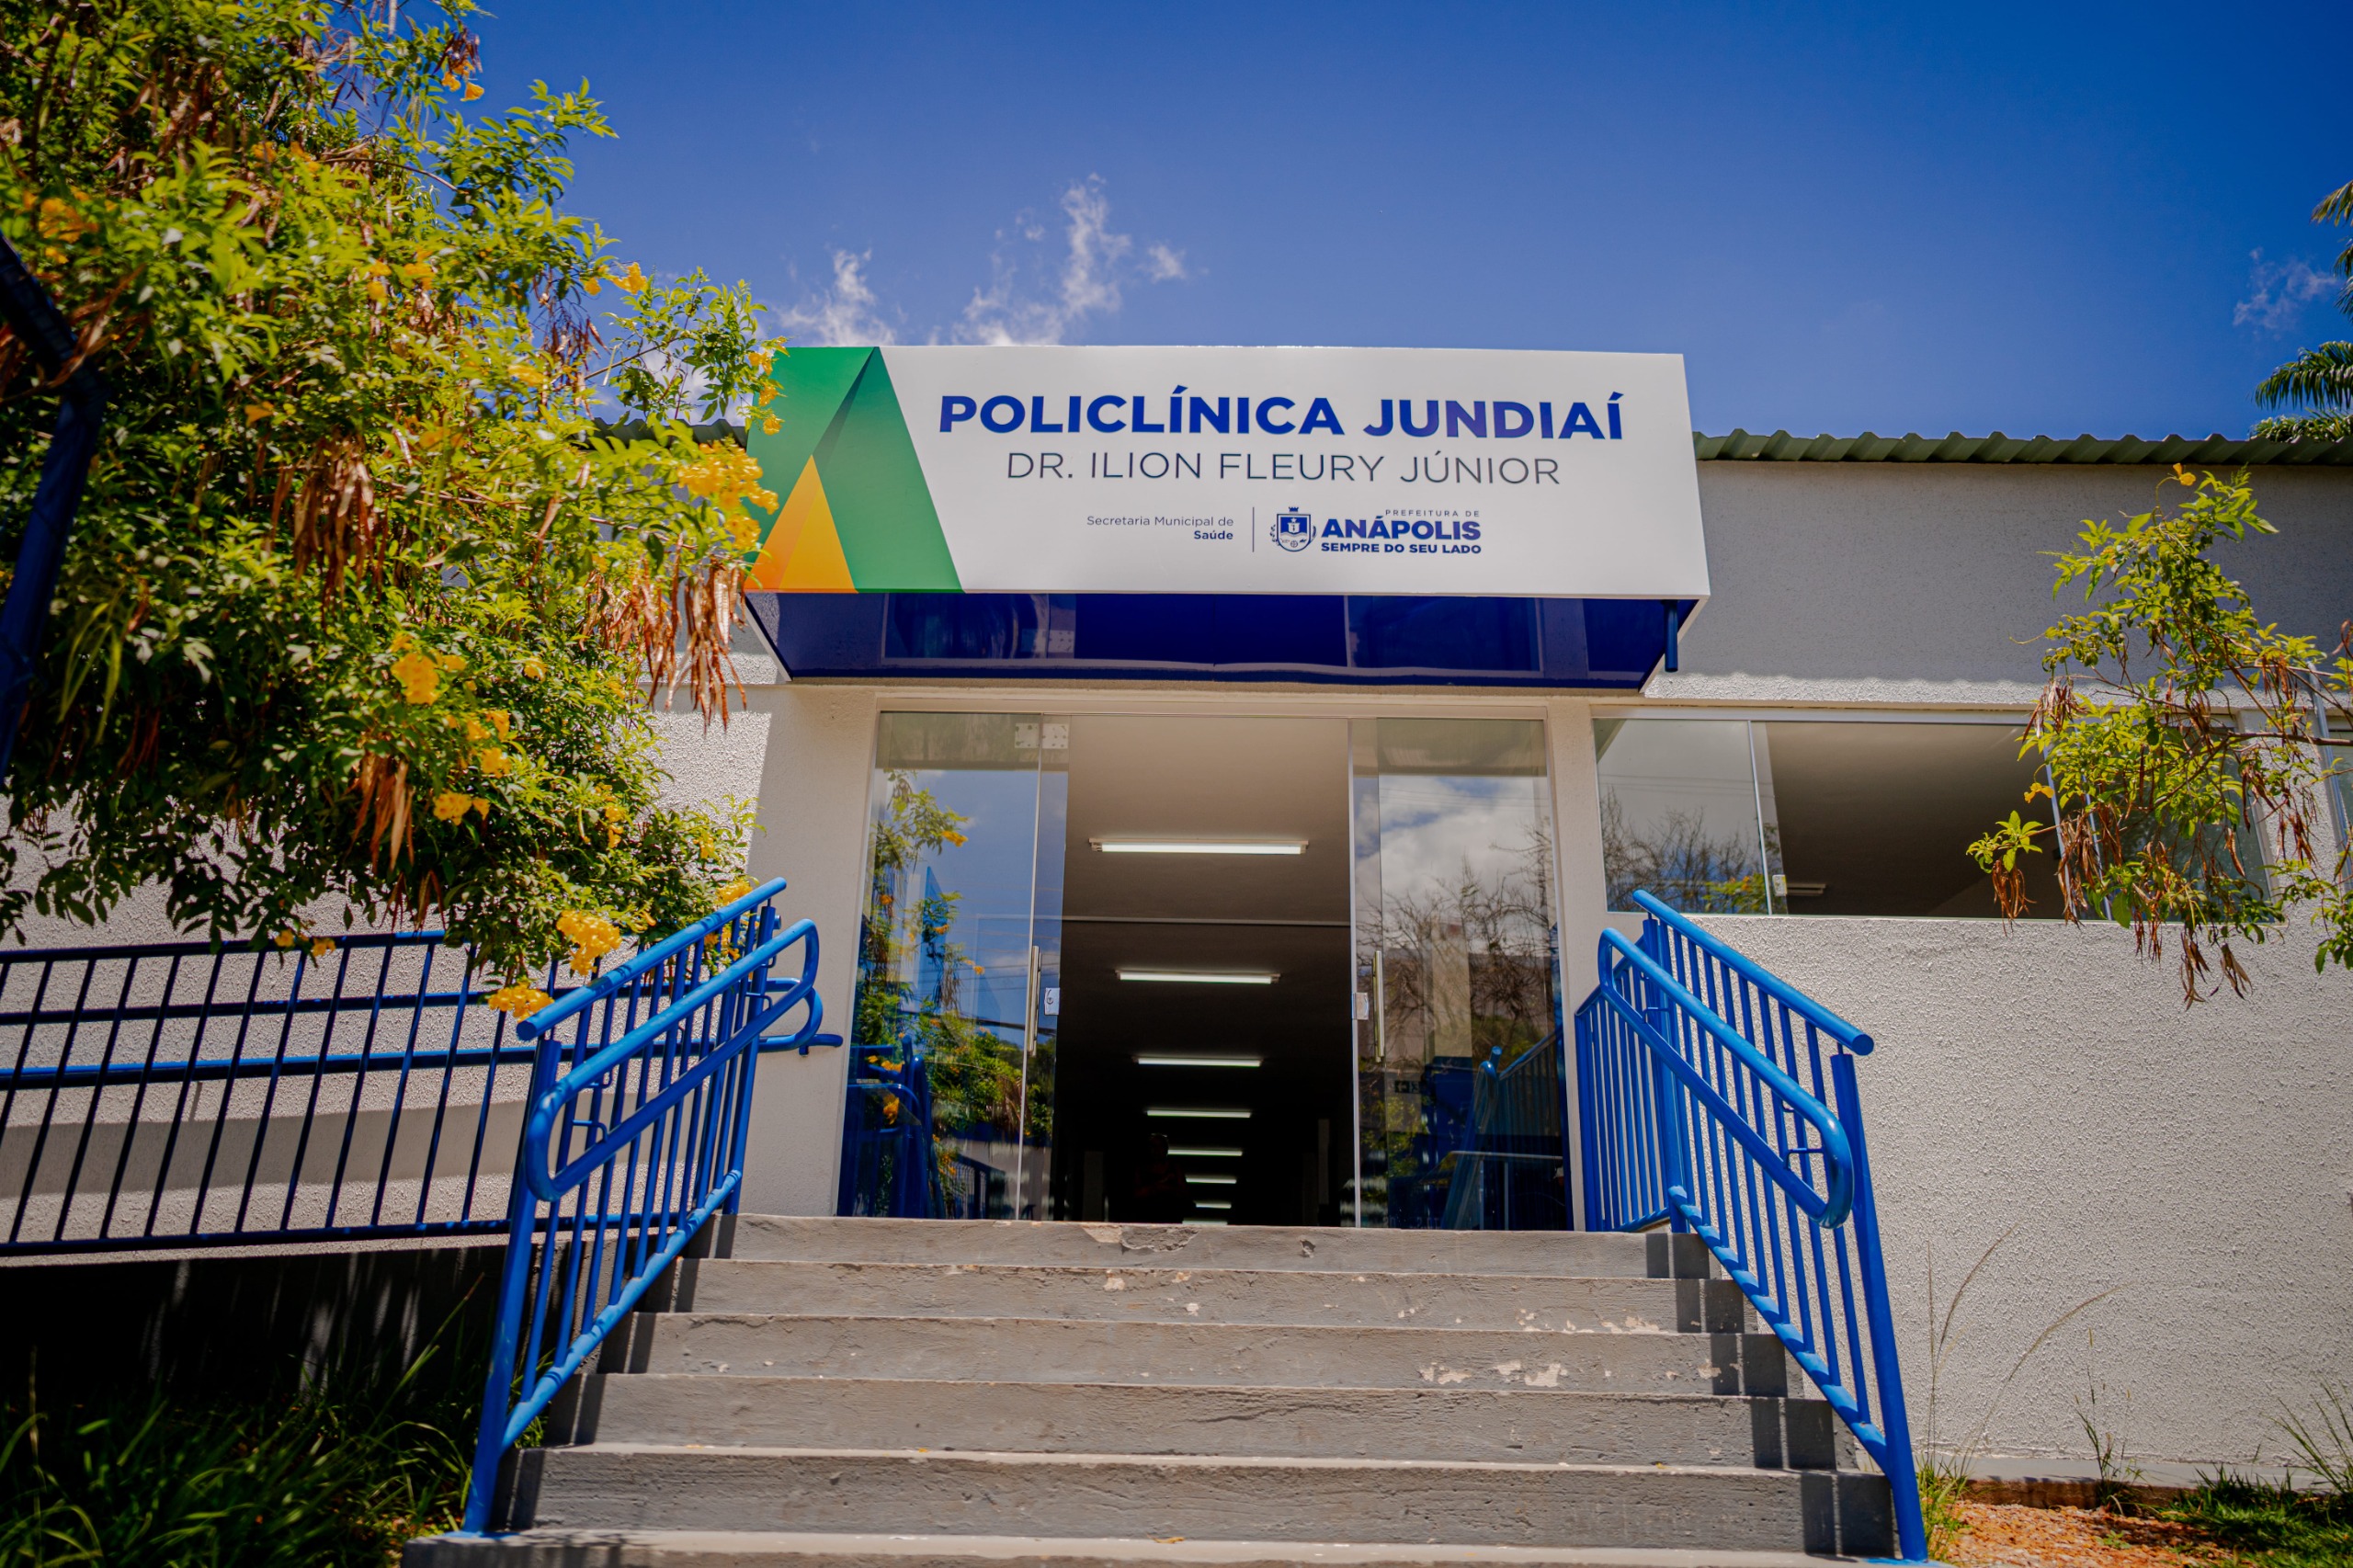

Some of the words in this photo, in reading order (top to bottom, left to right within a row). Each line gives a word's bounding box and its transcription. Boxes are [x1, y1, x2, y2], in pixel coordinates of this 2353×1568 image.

[939, 385, 1346, 436] POLICLÍNICA
[1362, 392, 1624, 440] JUNDIAÍ
[1007, 452, 1074, 479] DR.
[1091, 452, 1201, 479] ILION
[1220, 453, 1385, 482] FLEURY
[1400, 449, 1560, 485] JÚNIOR
[1385, 509, 1458, 517] PREFEITURA
[1465, 509, 1480, 517] DE
[1086, 515, 1151, 527] Secretaria
[1155, 517, 1214, 528] Municipal
[1218, 517, 1234, 528] de
[1321, 516, 1482, 540] ANÁPOLIS
[1193, 529, 1233, 540] Saúde
[1321, 542, 1380, 553] SEMPRE
[1383, 543, 1405, 553] DO
[1409, 543, 1438, 554] SEU
[1441, 544, 1482, 554] LADO
